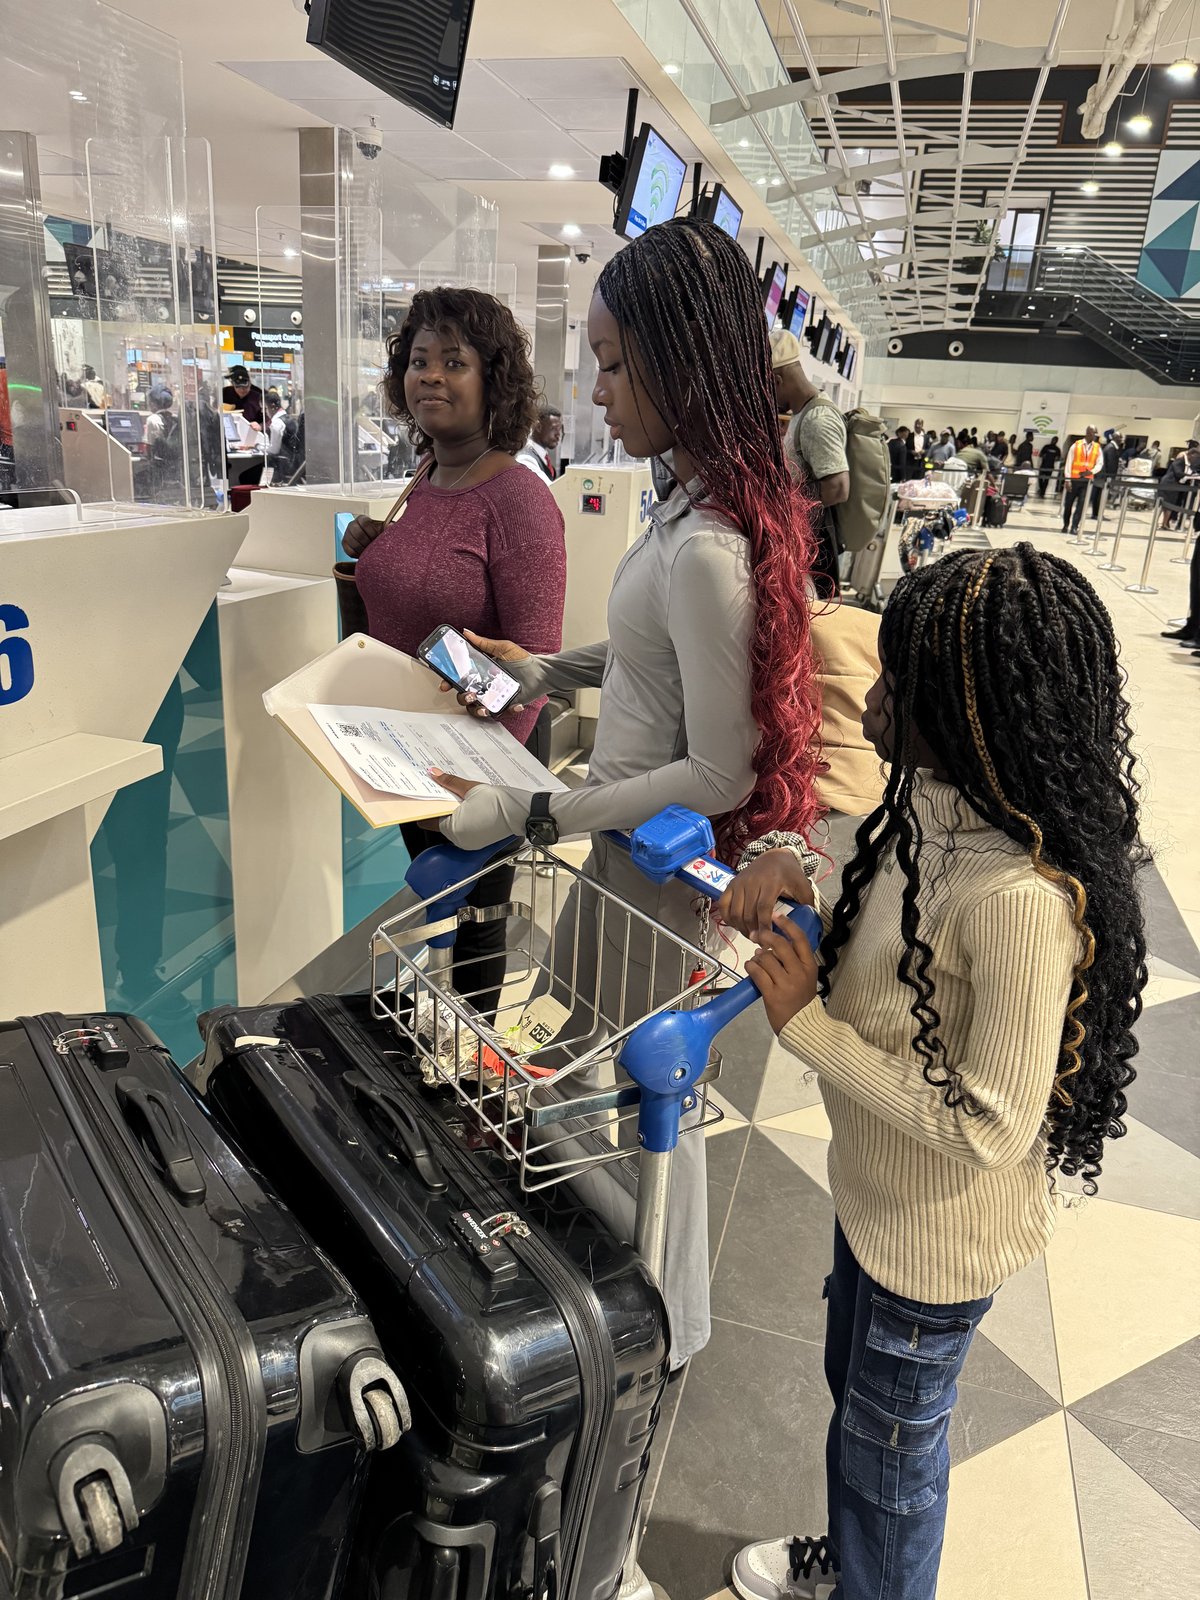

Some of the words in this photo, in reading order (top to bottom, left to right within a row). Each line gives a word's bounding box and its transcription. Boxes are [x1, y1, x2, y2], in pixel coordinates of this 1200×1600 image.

[0, 604, 34, 706] 6
[531, 1025, 551, 1042] ACC
[466, 1217, 488, 1239] WENGER
